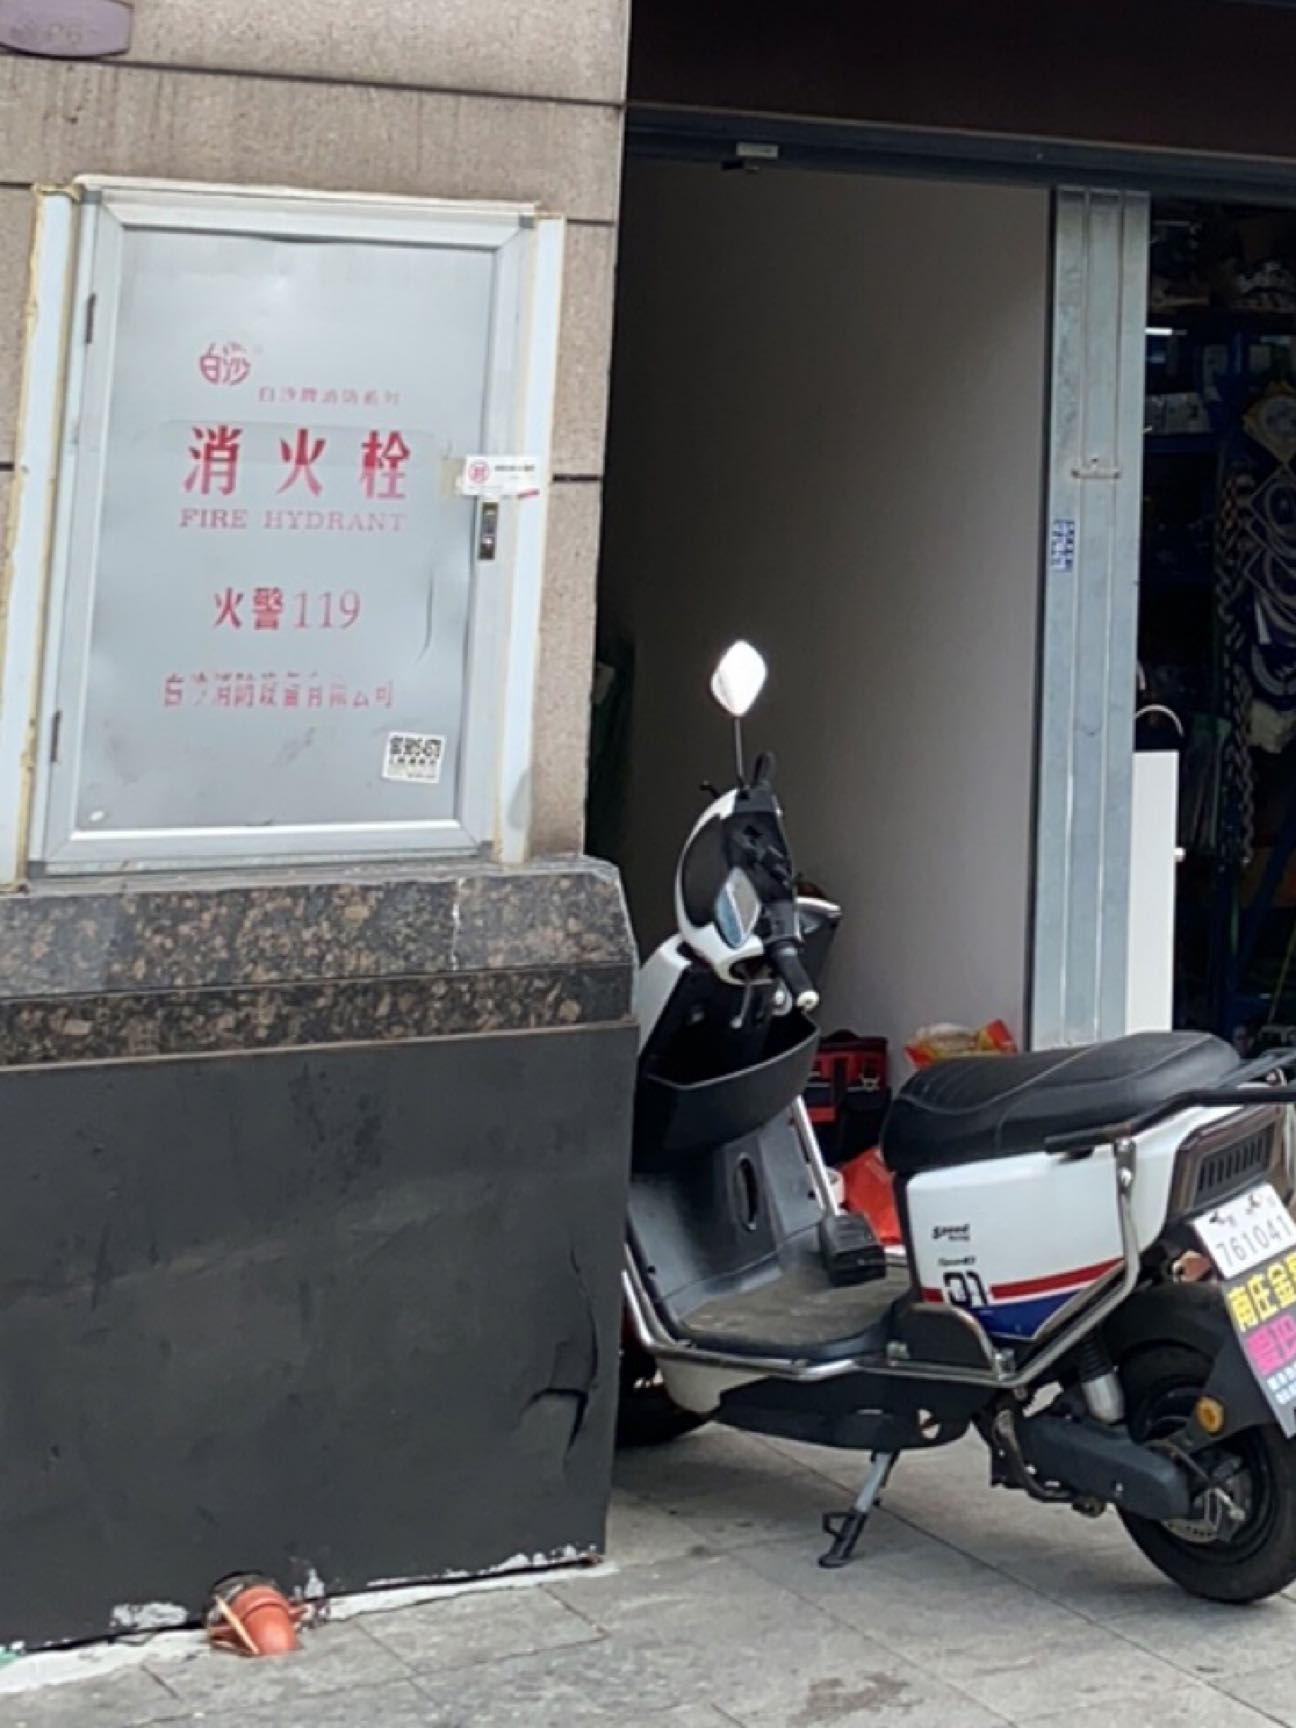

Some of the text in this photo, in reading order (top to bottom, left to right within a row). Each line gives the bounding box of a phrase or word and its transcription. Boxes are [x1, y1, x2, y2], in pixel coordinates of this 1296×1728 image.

[182, 424, 412, 500] 消火栓
[179, 507, 407, 532] FIRE HYDRANT
[212, 586, 362, 632] 火警119
[1215, 1216, 1292, 1267] 761041
